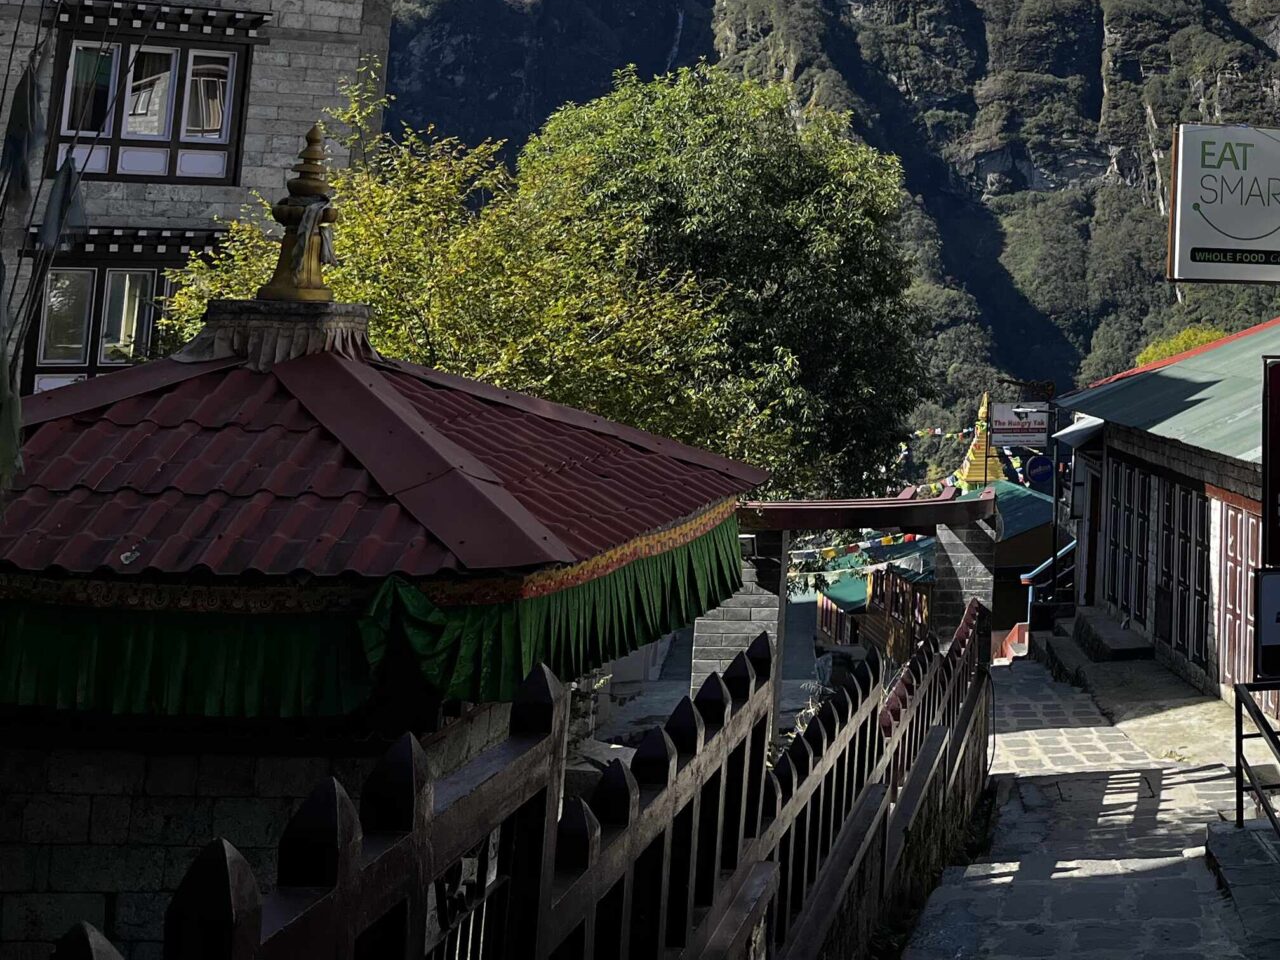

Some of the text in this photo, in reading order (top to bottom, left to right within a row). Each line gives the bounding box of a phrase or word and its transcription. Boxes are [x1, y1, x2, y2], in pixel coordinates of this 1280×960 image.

[1201, 141, 1254, 170] EAT
[1195, 252, 1233, 261] WHOLE
[1236, 253, 1265, 262] FOOD
